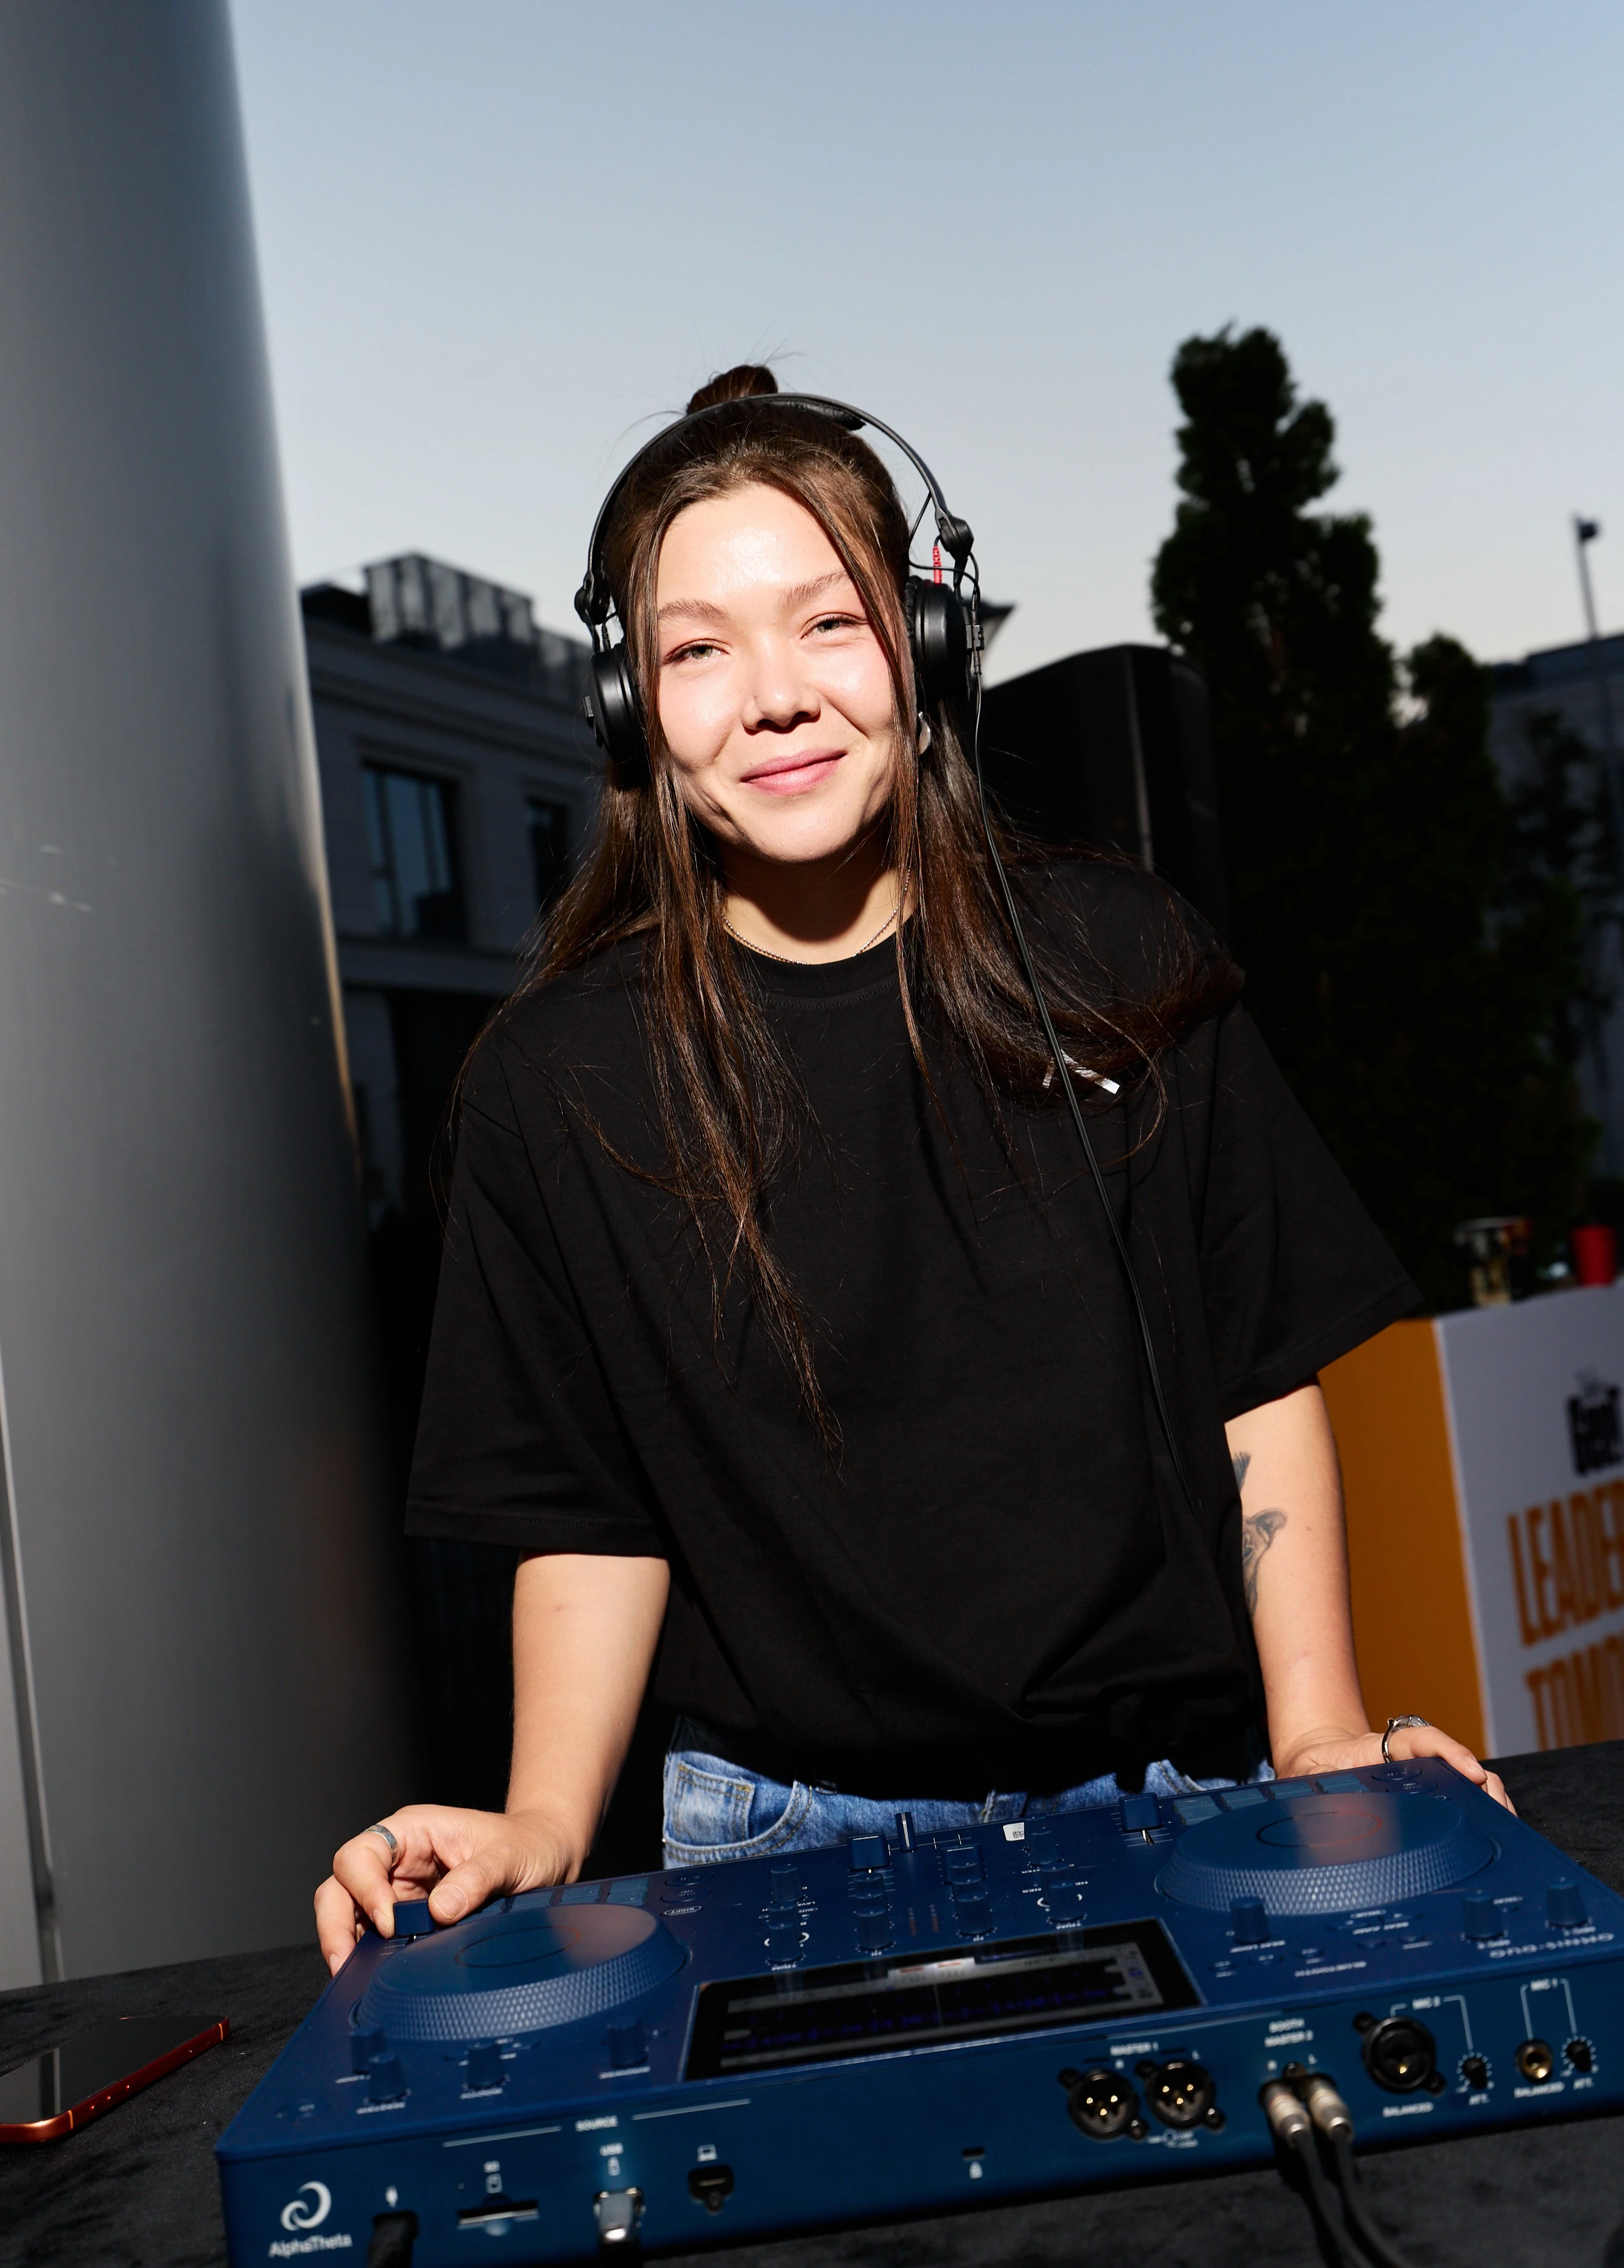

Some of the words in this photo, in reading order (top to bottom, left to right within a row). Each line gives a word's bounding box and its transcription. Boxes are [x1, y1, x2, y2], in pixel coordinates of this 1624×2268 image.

[1268, 2017, 1306, 2033] BOOTH
[1264, 2030, 1306, 2048] MASTER
[1109, 2041, 1152, 2057] MASTER
[575, 2115, 618, 2132] SOURCE
[268, 2233, 353, 2258] AlphaTheta
